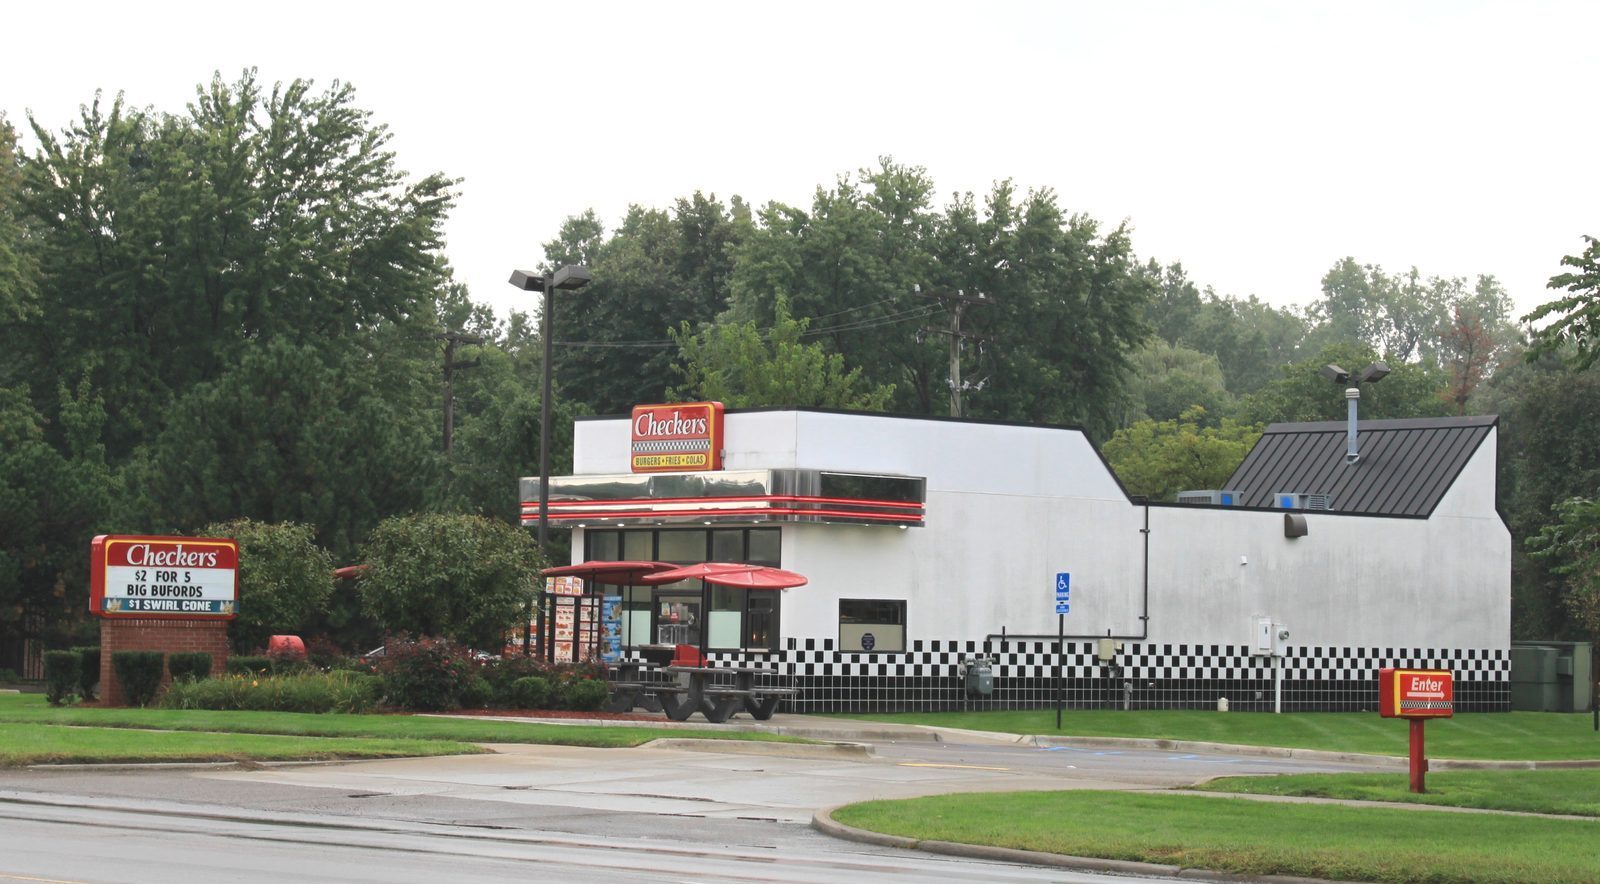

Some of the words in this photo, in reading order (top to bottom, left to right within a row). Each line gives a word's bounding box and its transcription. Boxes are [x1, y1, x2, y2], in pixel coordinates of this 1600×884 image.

[635, 411, 706, 436] Checkers
[635, 456, 661, 466] BURGERS
[665, 455, 681, 465] FRIES
[686, 454, 704, 464] COLAS
[126, 544, 217, 567] Checkers
[135, 570, 147, 582] $2
[155, 571, 178, 583] FOR
[184, 571, 191, 583] 5
[127, 584, 147, 596] BIG
[151, 585, 203, 597] BUFORDS
[128, 600, 140, 610] $1
[143, 600, 179, 611] SWIRL
[182, 601, 211, 611] CONE
[1411, 677, 1443, 691] Enter
